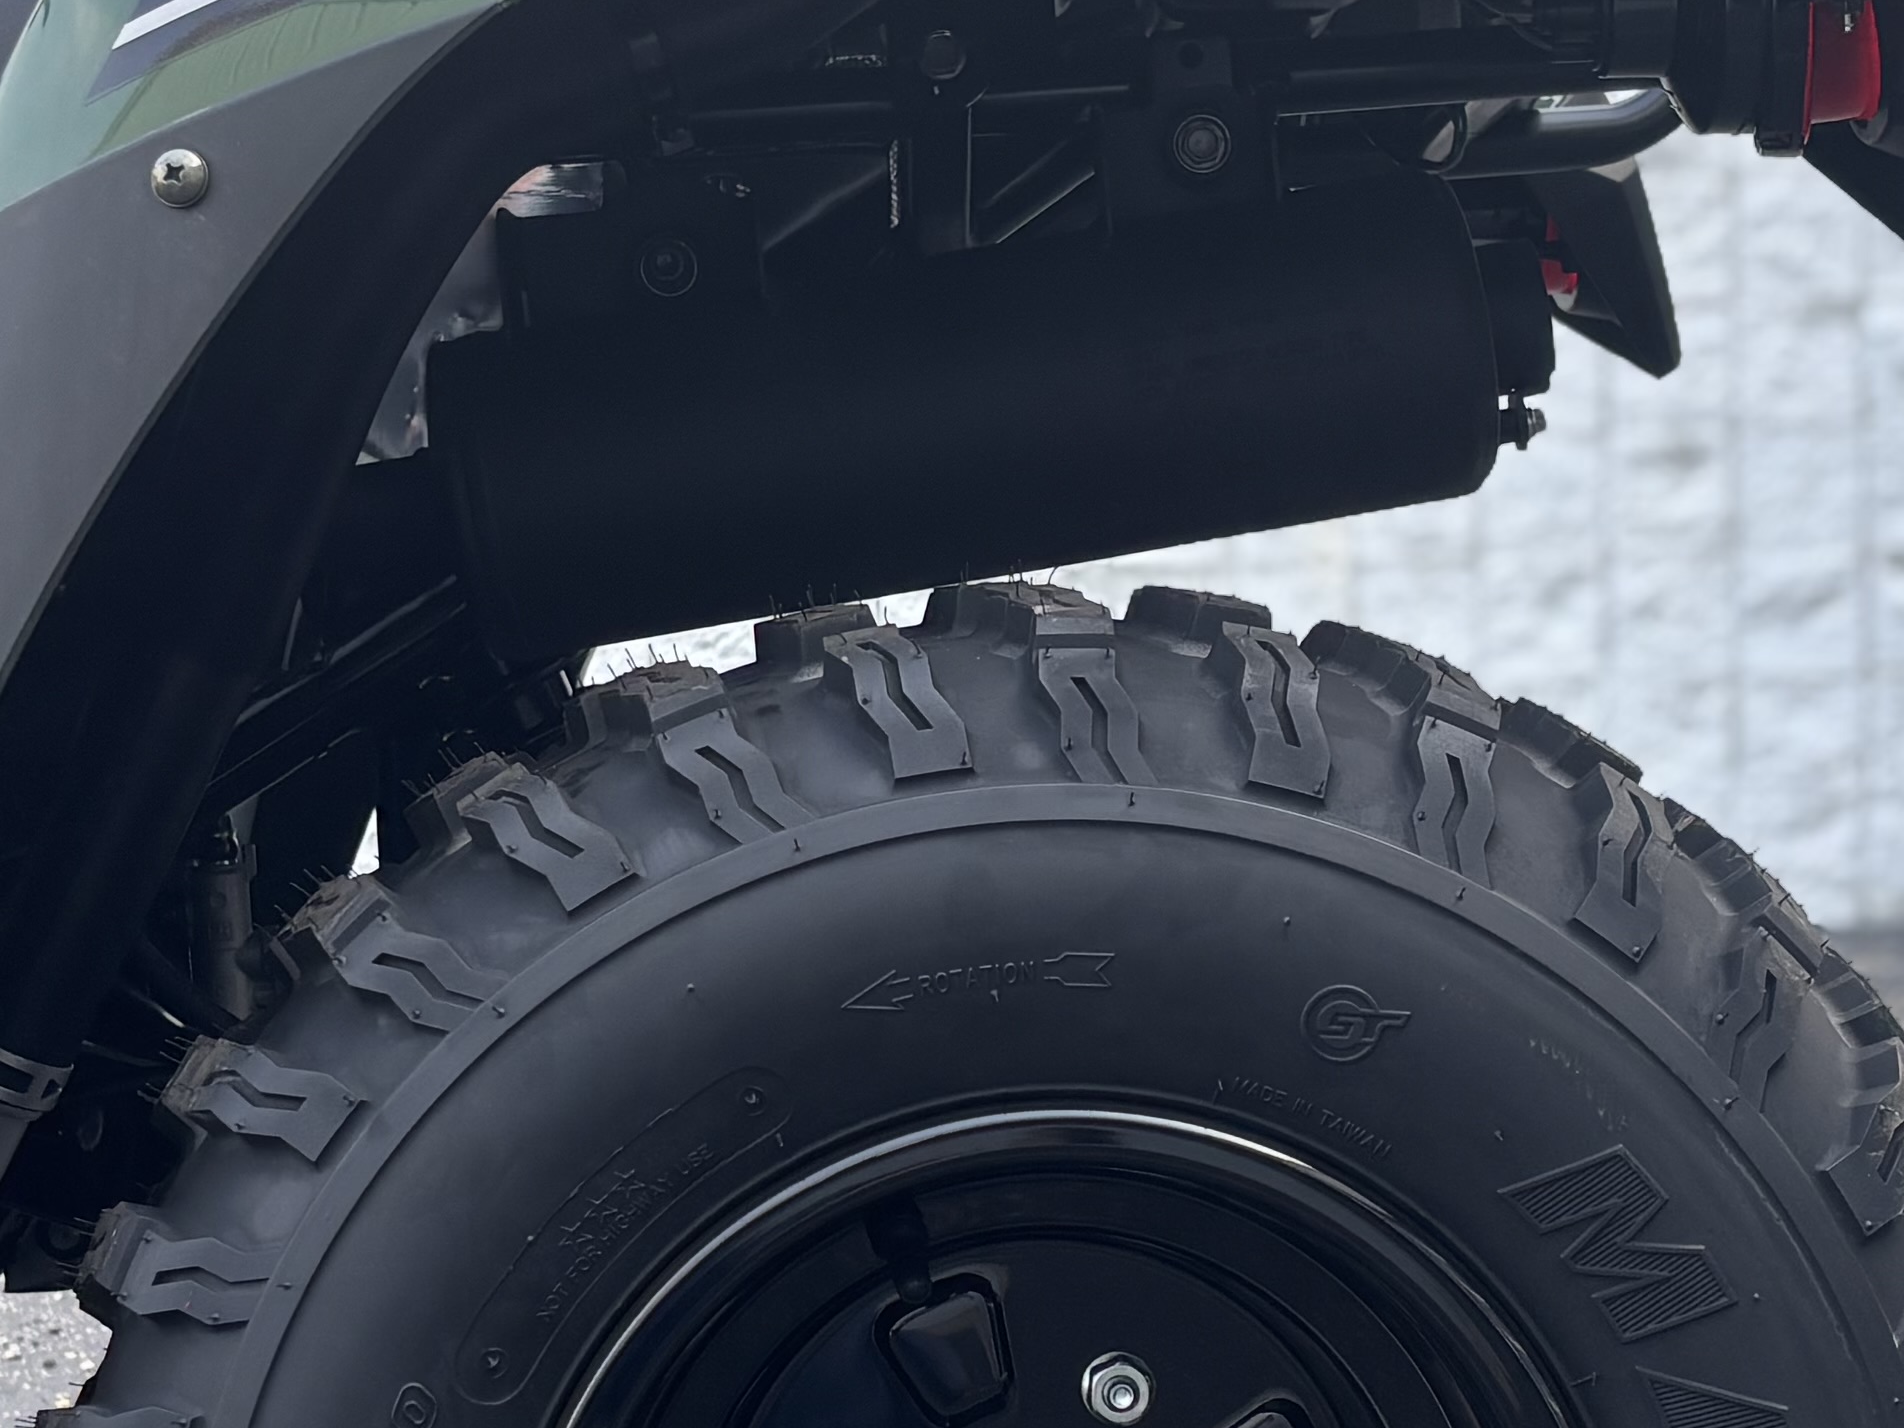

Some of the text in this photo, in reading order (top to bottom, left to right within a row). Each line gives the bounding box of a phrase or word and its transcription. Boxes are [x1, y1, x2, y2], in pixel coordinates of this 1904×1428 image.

[916, 961, 1034, 997] ROTATION
[534, 1142, 714, 1324] NOT FOR HIGHWAY USE
